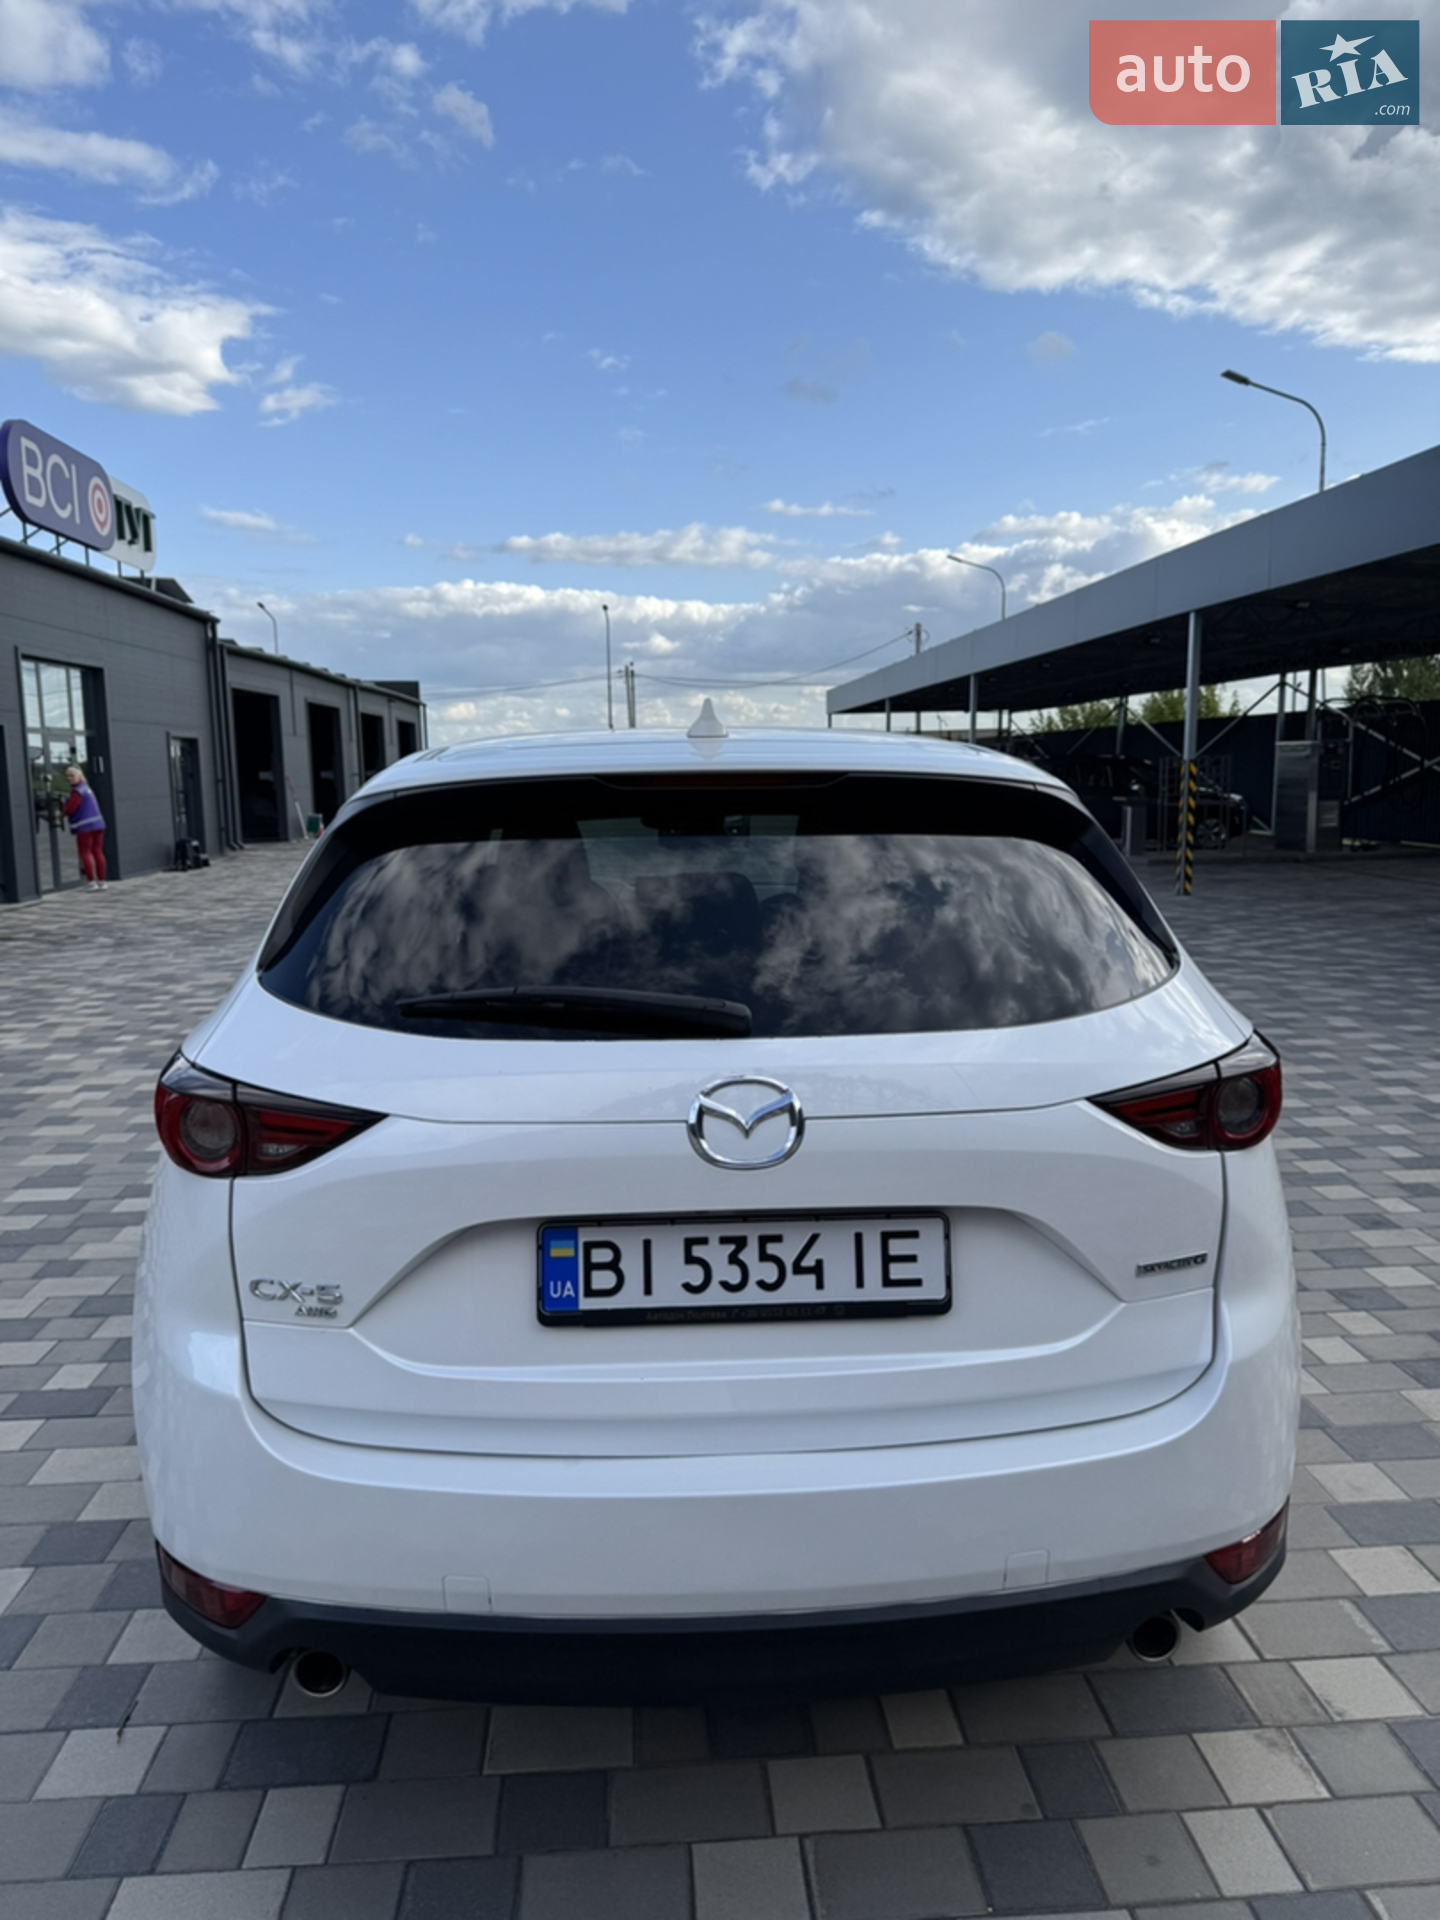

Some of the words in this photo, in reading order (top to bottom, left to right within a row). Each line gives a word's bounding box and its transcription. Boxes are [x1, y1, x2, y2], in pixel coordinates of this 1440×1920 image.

[582, 1238, 653, 1298] BI
[680, 1233, 824, 1294] 5354
[853, 1229, 924, 1289] IE
[248, 1278, 344, 1306] CX-5
[549, 1280, 576, 1299] UA
